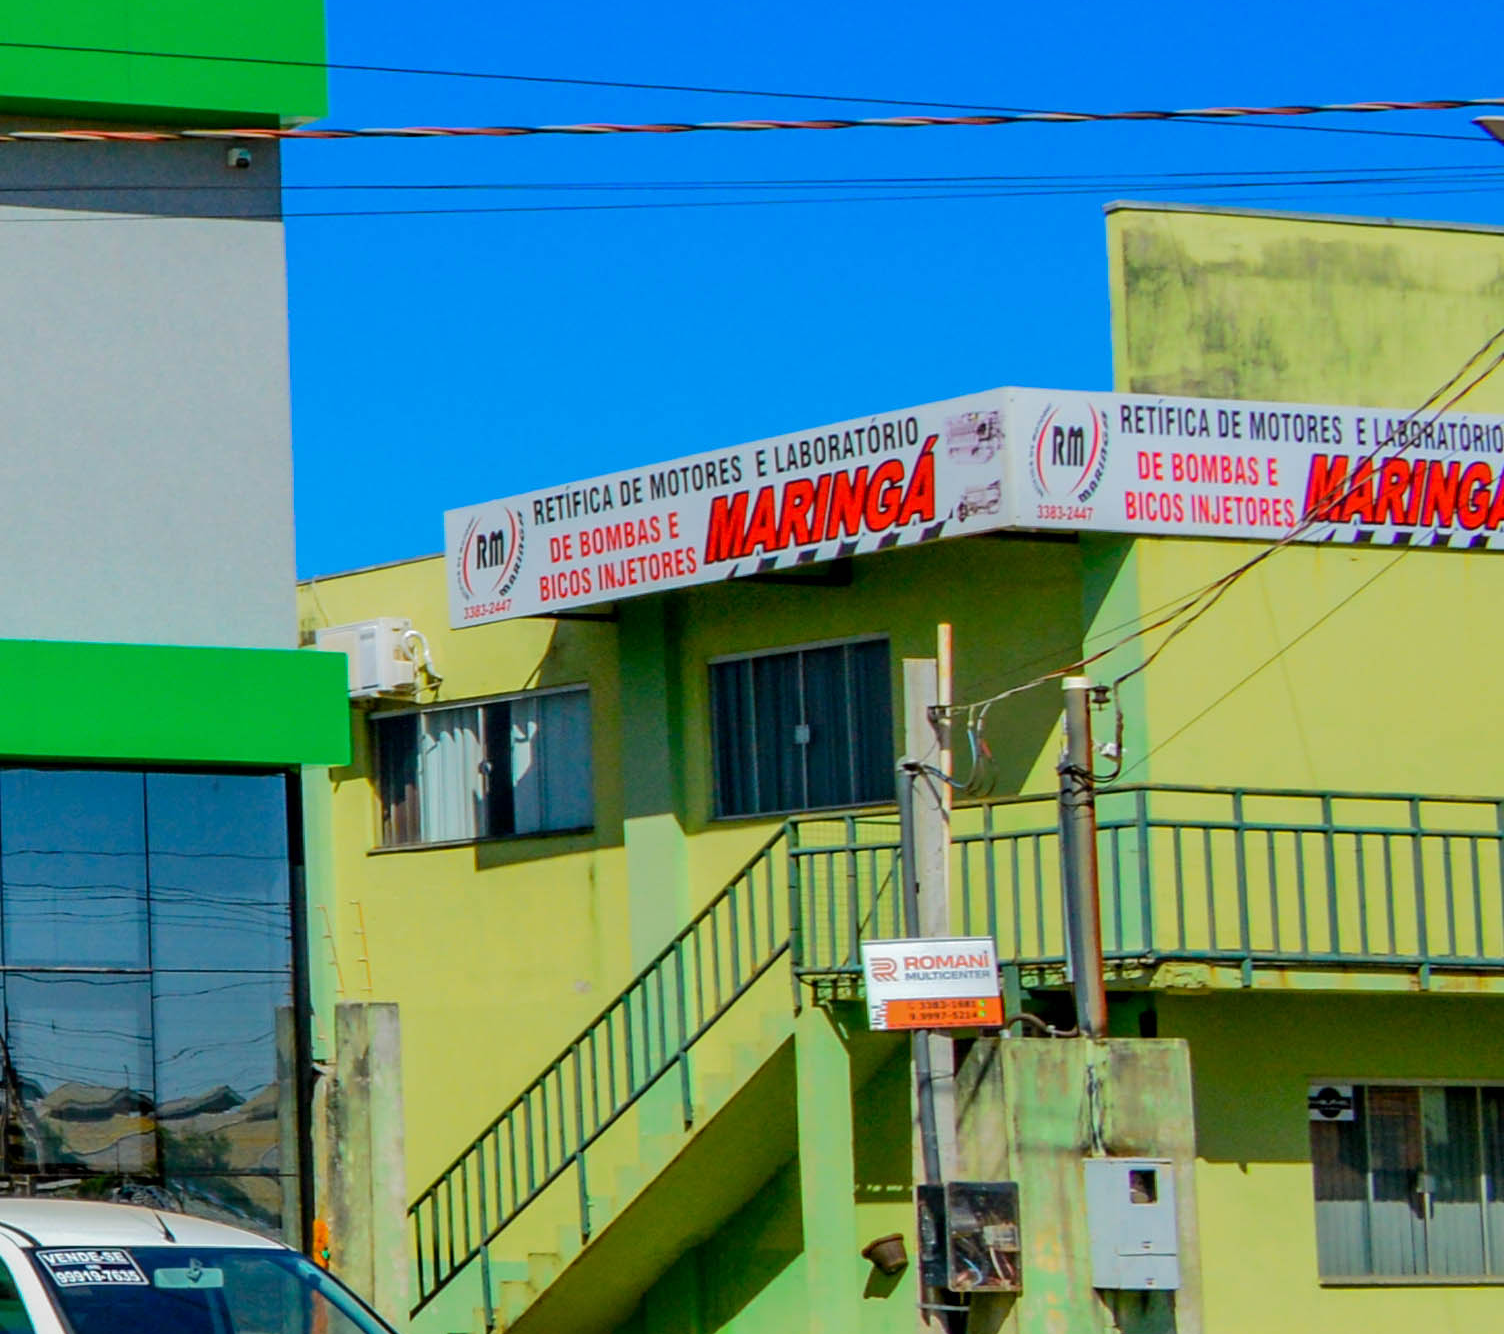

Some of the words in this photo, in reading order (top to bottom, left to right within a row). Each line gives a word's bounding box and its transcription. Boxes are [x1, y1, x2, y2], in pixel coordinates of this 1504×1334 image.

[1121, 399, 1210, 438] RETÍFICA
[1217, 409, 1241, 439] DE
[1249, 410, 1343, 445] MOTORES
[1356, 417, 1366, 445] E
[533, 486, 614, 525] RETÍFICA
[620, 477, 643, 507] DE
[649, 455, 742, 500] MOTORES
[755, 450, 766, 478] E
[774, 417, 919, 473] LABORATÓRIO
[1137, 451, 1163, 481] DE
[1171, 452, 1259, 486] BOMBAS
[1267, 457, 1279, 487] E
[704, 434, 939, 564] MARINGÁ
[1037, 504, 1094, 520] 3383-2447
[1124, 491, 1184, 523] BICOS
[1191, 494, 1296, 529] INJETORES
[549, 536, 573, 563] DE
[579, 515, 661, 558] BOMBAS
[668, 512, 679, 539] E
[539, 568, 592, 602] BICOS
[598, 547, 697, 591] INJETORES
[463, 598, 512, 620] 3383-2447
[904, 970, 990, 982] MULTICENTER
[42, 1251, 128, 1265] VENDE-SE
